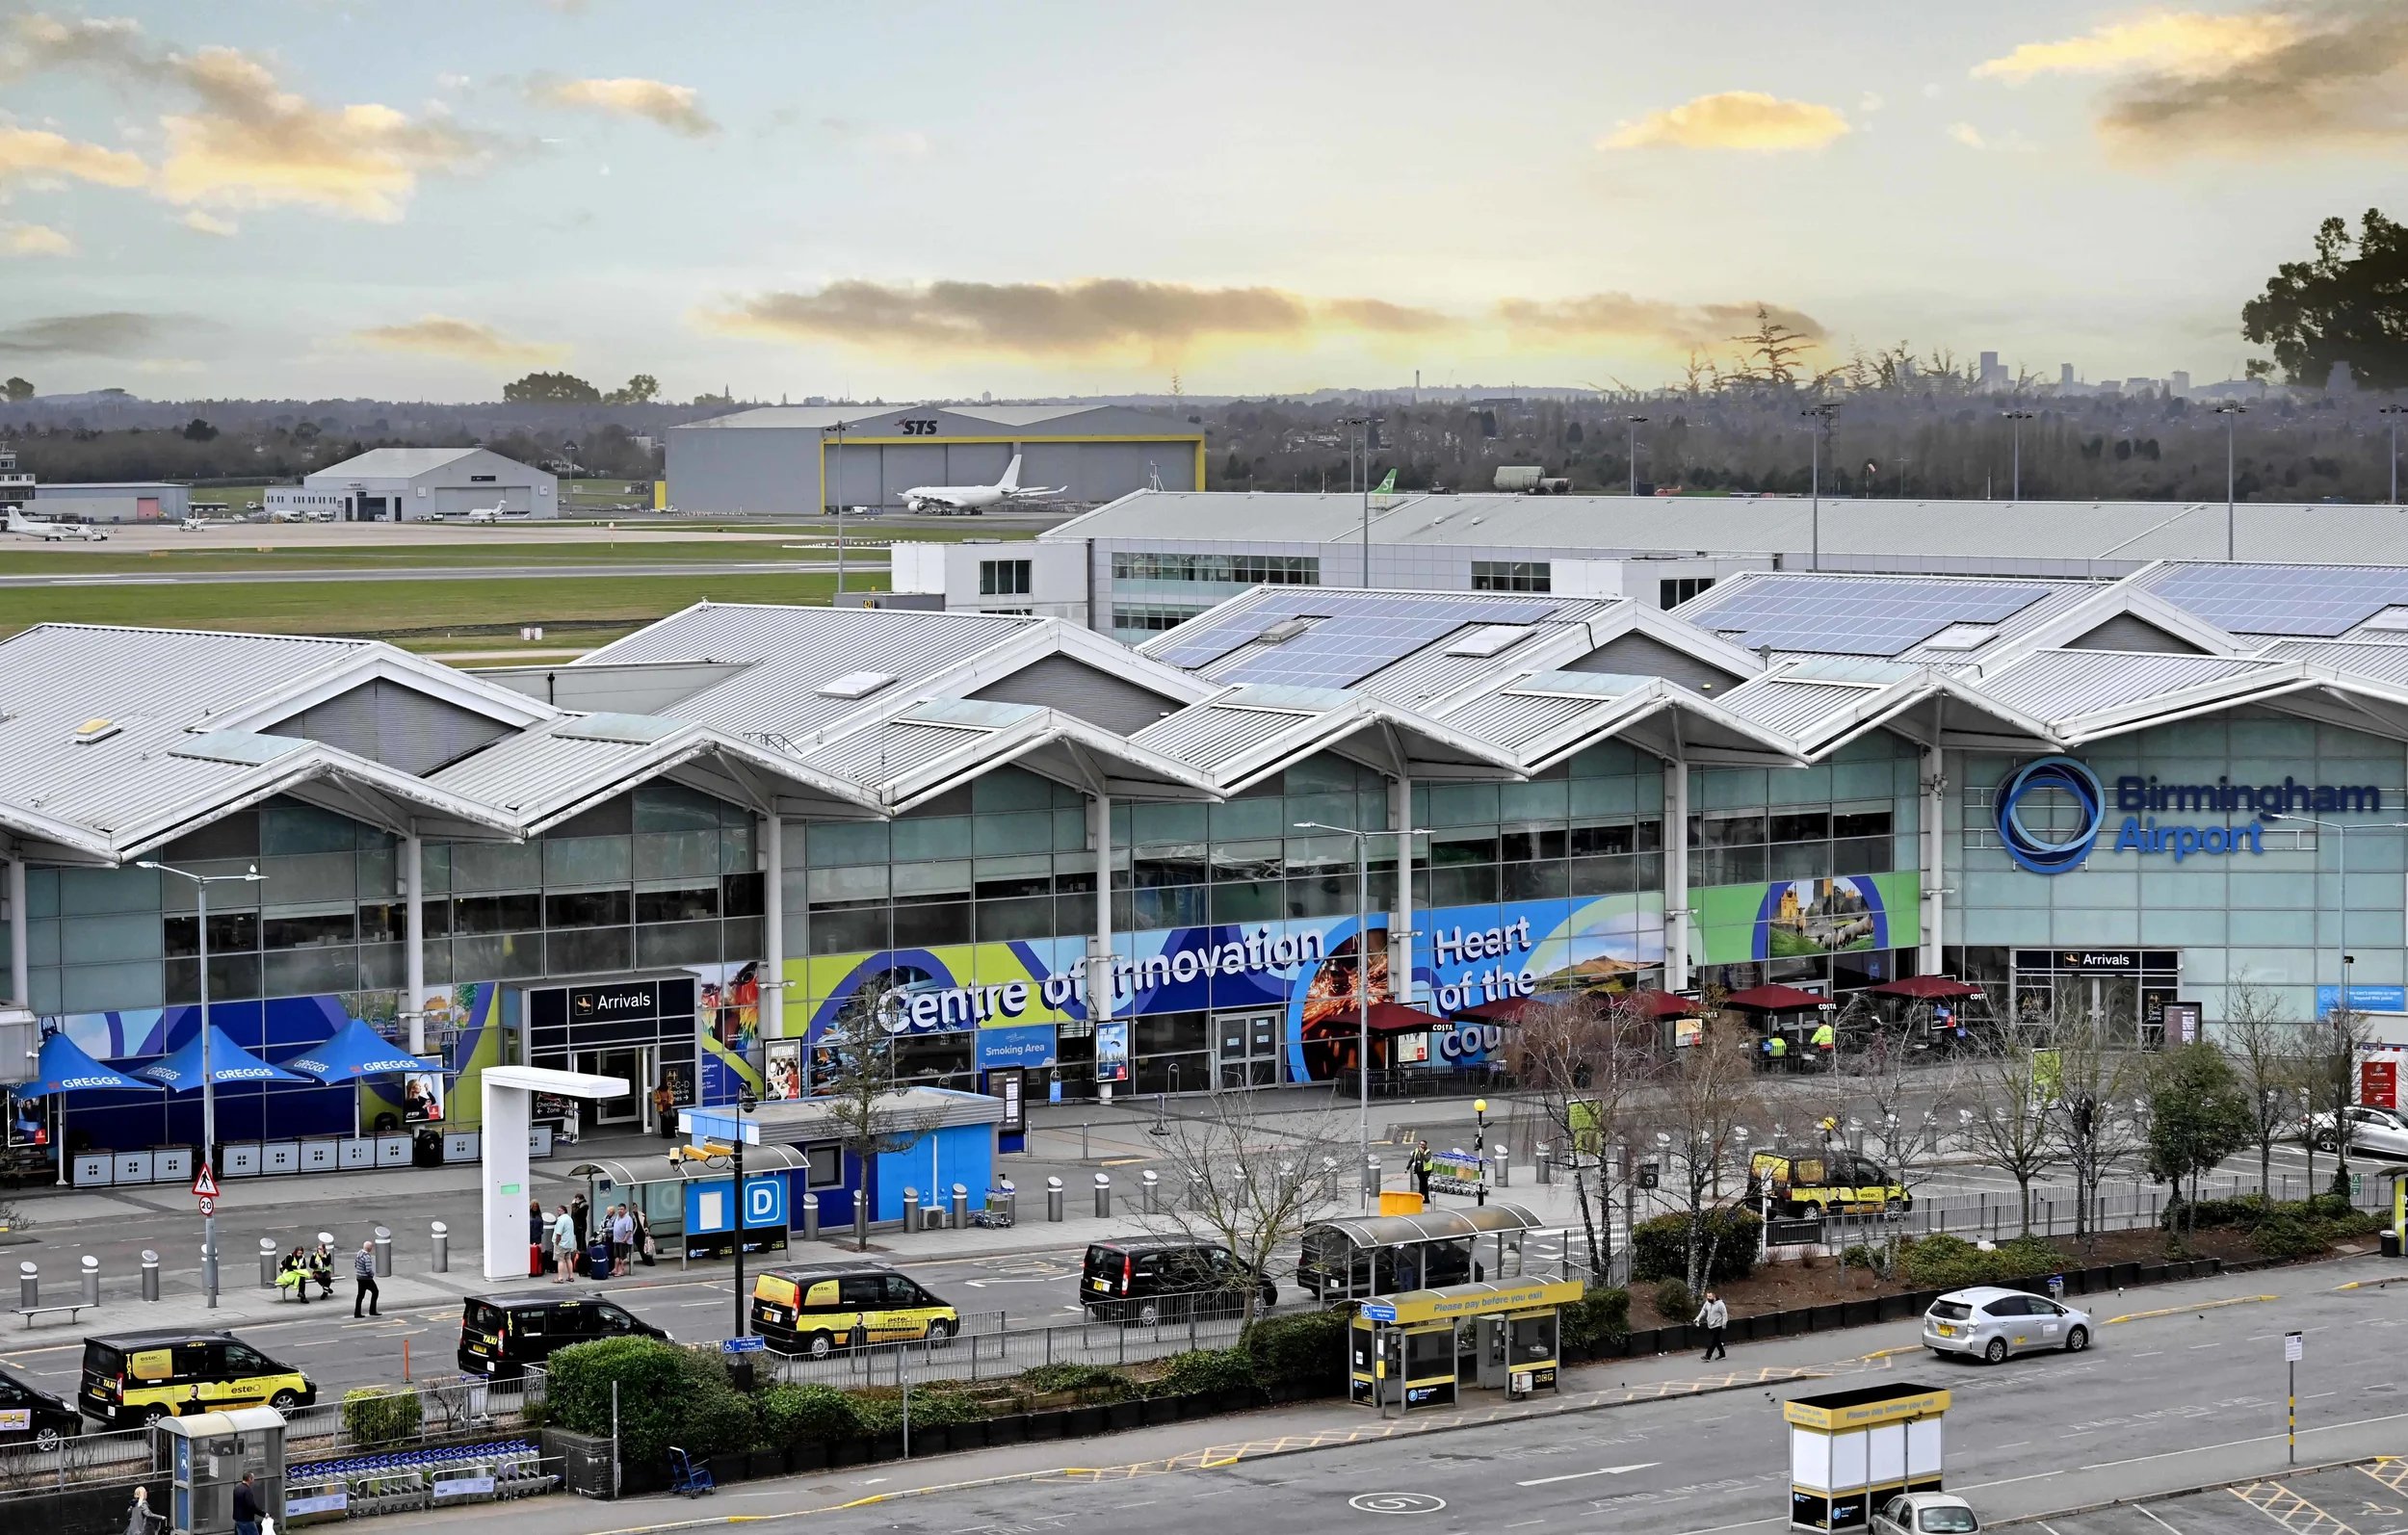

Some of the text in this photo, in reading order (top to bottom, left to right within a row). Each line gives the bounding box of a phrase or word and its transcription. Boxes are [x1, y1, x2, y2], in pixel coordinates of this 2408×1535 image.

[903, 420, 937, 434] STS
[2118, 775, 2380, 821] Birmingham
[2114, 817, 2264, 863] Airport
[1436, 916, 1531, 965] Heart
[2083, 954, 2130, 965] Arrivals
[877, 922, 1325, 1032] Centre of nnovation
[1440, 965, 1535, 1010] of the
[597, 992, 650, 1009] Arrivals
[772, 1046, 795, 1057] NOTHING
[986, 1043, 1045, 1055] Smoking Area
[294, 1059, 328, 1073] GREGGS
[363, 1060, 418, 1071] GREGGS
[146, 1067, 181, 1080] GREGGS
[216, 1068, 274, 1080] GREGGS
[62, 1077, 121, 1088] GREGGS
[201, 1201, 212, 1210] 20
[753, 1189, 772, 1214] D
[1434, 1302, 1462, 1313] Please
[1464, 1301, 1479, 1311] pay
[1481, 1296, 1508, 1307] before
[1528, 1291, 1542, 1300] exit
[483, 1335, 498, 1345] TAXI
[103, 1379, 117, 1389] TAXI
[1535, 1373, 1554, 1382] NCP
[1846, 1411, 1869, 1419] Please
[1885, 1404, 1907, 1413] before
[1367, 1497, 1423, 1510] 5
